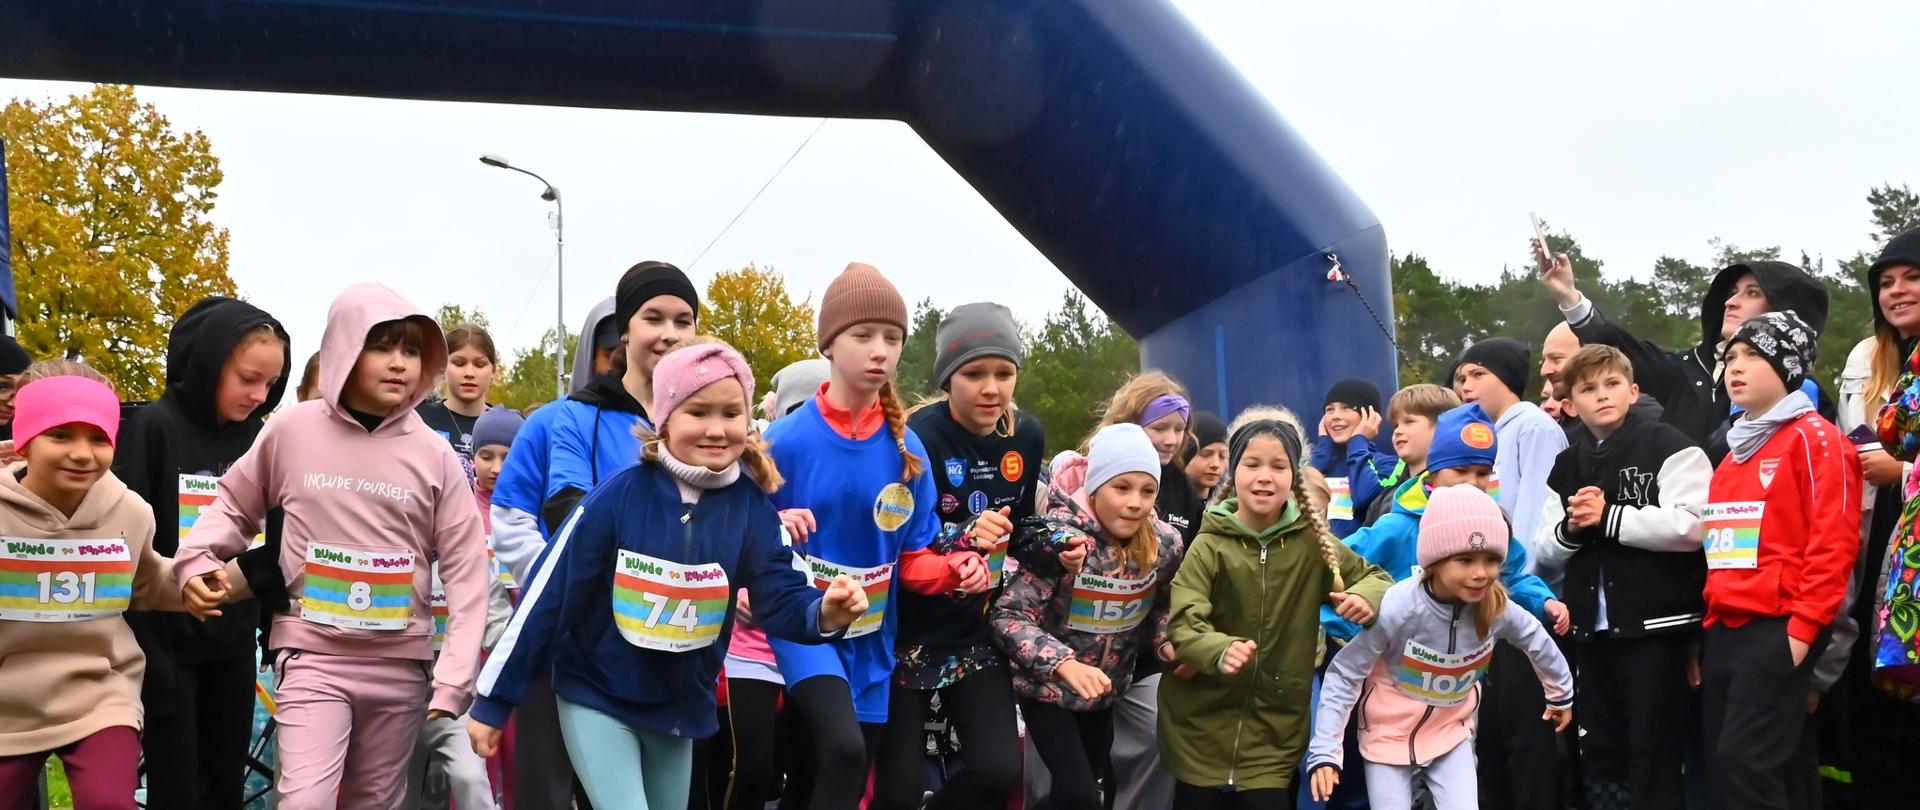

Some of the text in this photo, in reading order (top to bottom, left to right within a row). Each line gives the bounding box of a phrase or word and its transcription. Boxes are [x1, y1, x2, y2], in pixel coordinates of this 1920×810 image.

[947, 464, 963, 476] Nr2
[303, 472, 414, 504] INCLUDE YOURSELF
[1617, 466, 1654, 506] NY
[1707, 527, 1735, 553] 28
[37, 571, 96, 604] 131
[347, 581, 372, 611] 8
[642, 591, 699, 633] 74
[1092, 599, 1143, 622] 152
[1421, 669, 1477, 696] 102
